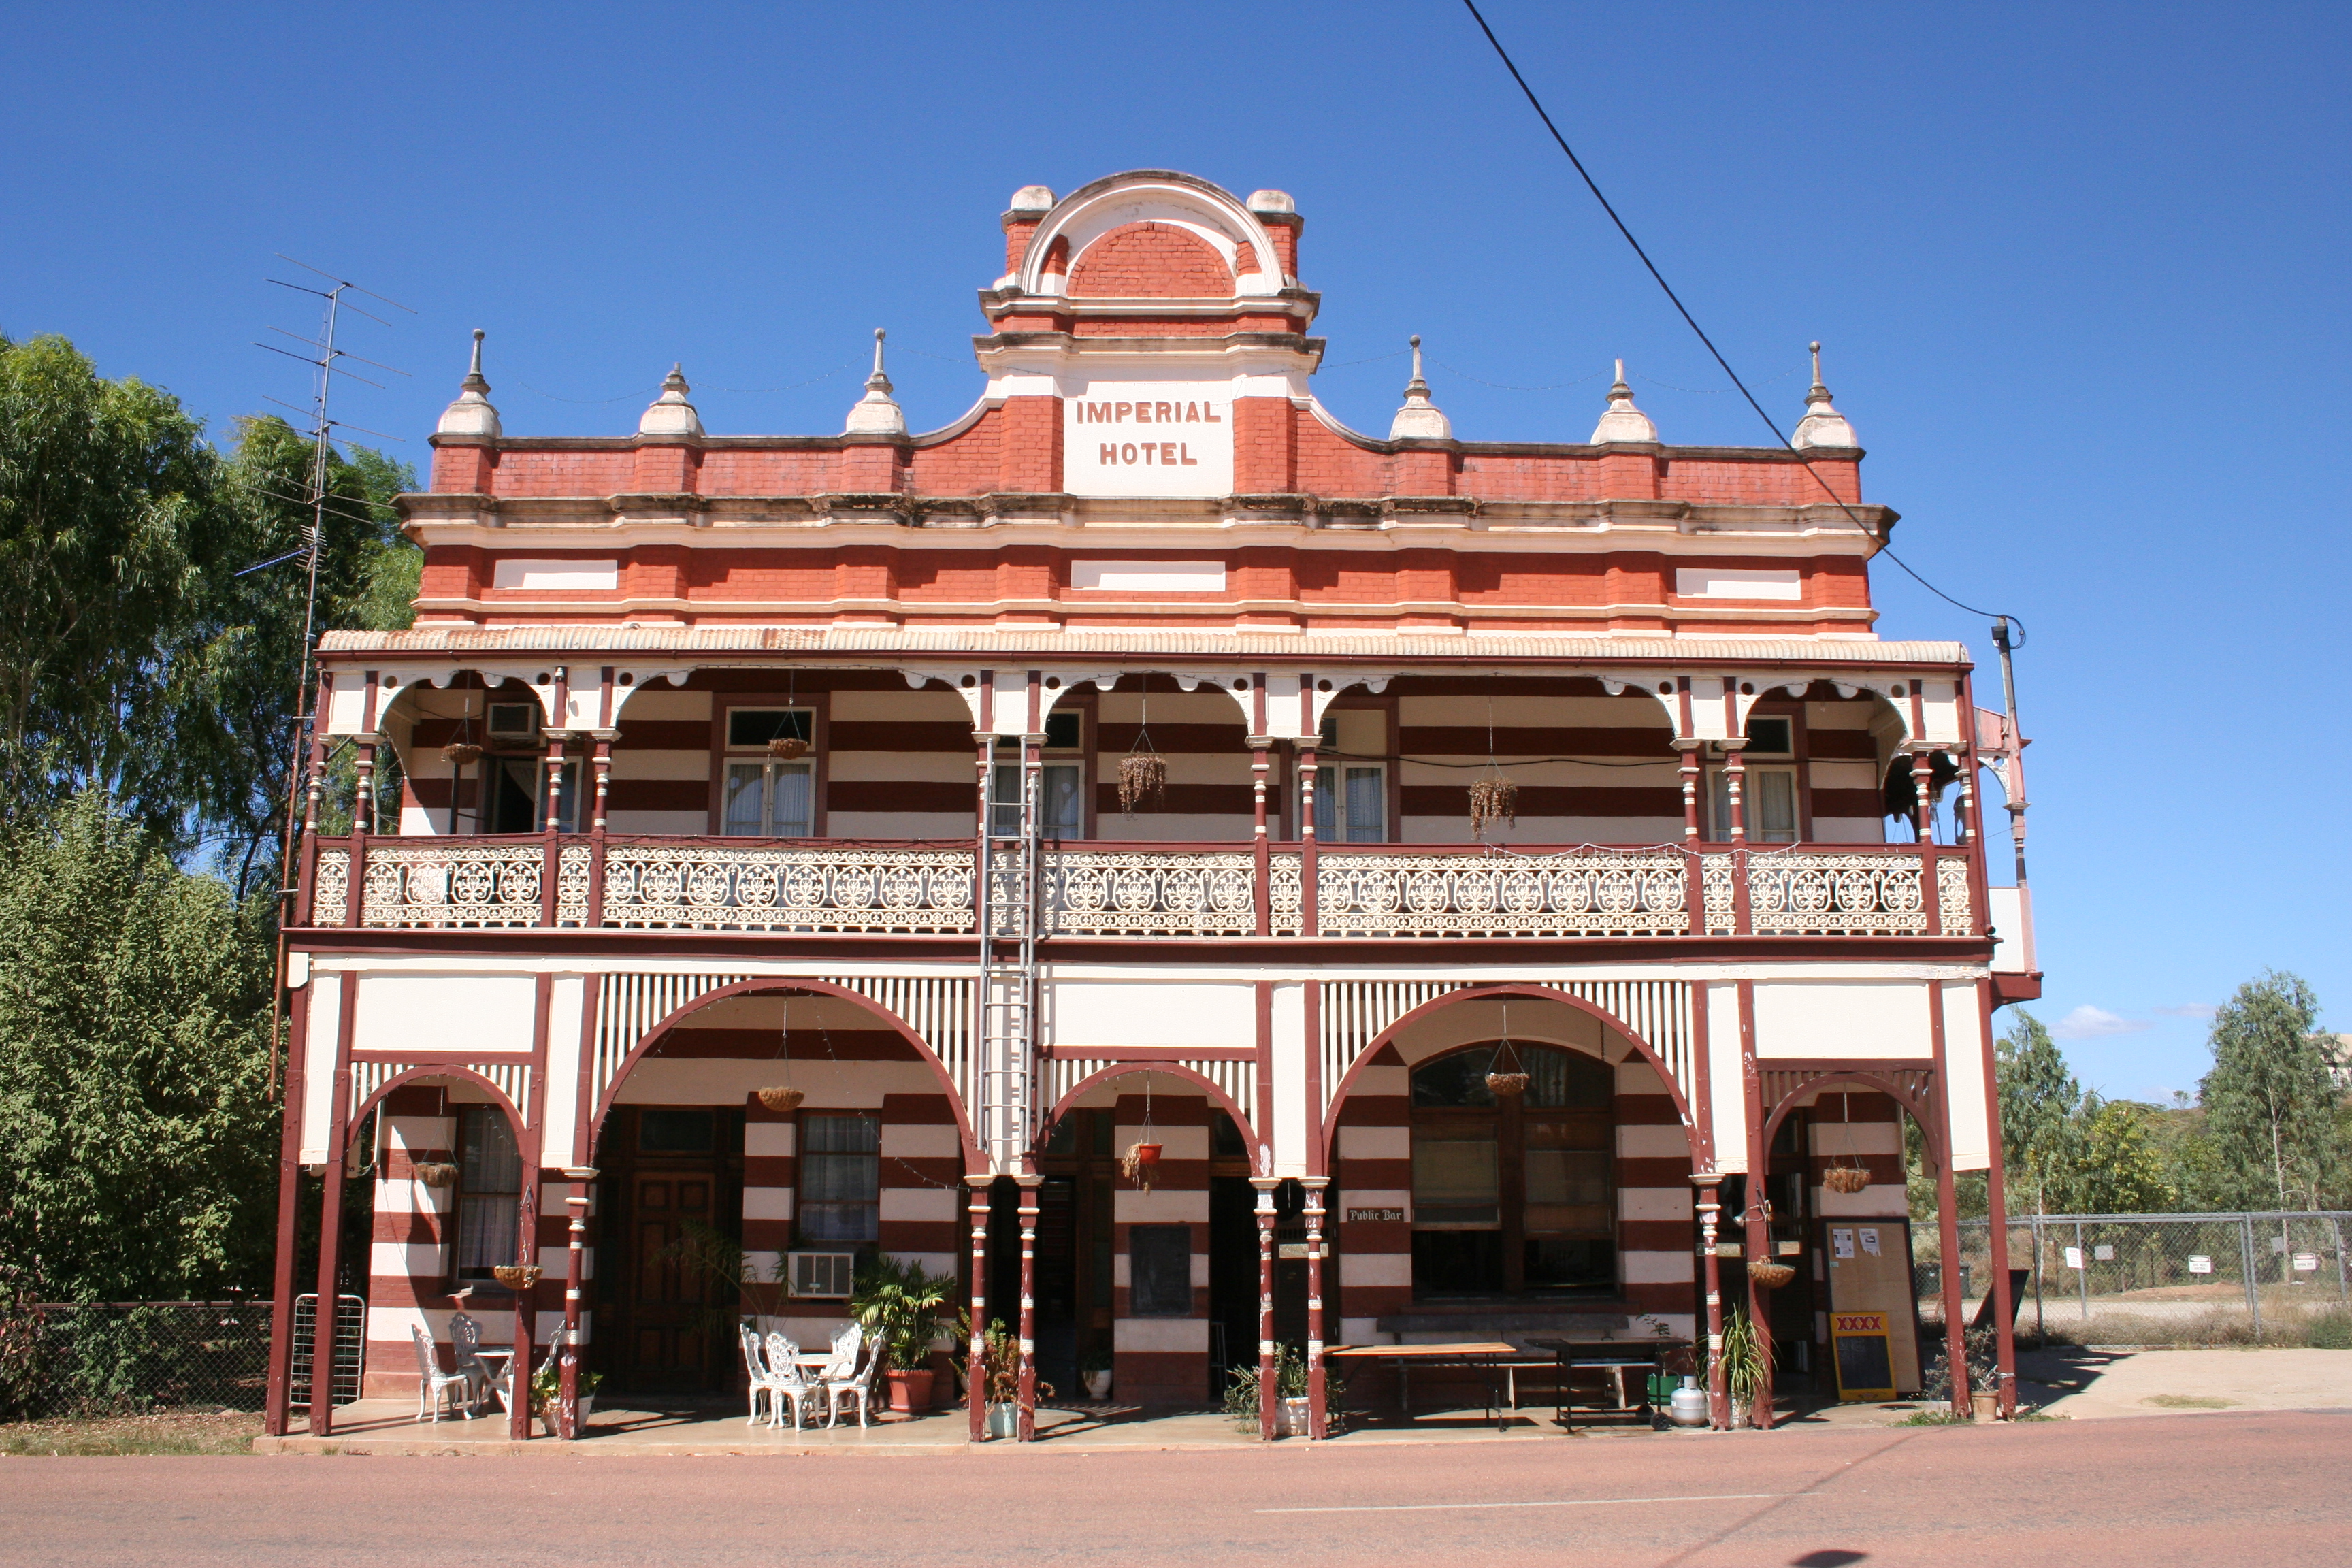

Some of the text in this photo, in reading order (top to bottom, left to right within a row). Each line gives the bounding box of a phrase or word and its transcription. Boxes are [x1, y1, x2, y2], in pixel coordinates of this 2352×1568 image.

[1077, 401, 1222, 424] IMPERIAL
[1100, 442, 1198, 466] HOTEL
[1349, 1209, 1402, 1220] Public Bar
[1836, 1316, 1882, 1330] XXXX
